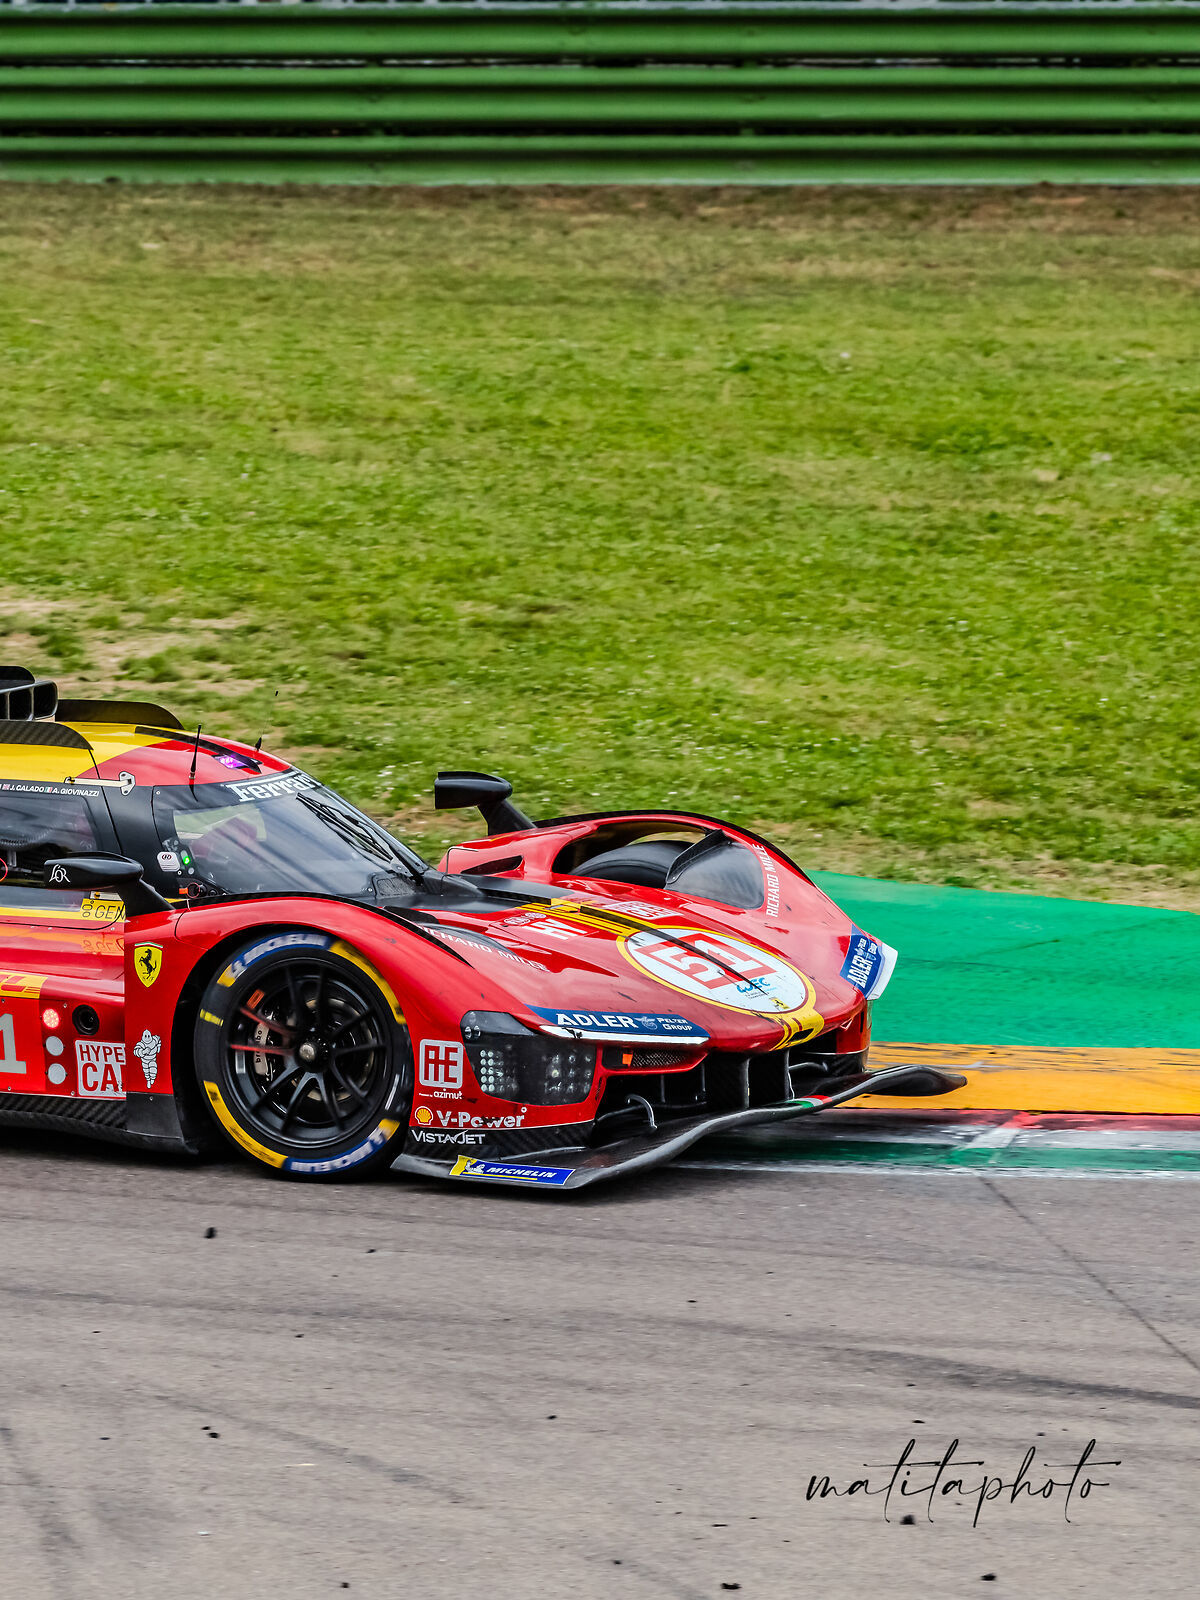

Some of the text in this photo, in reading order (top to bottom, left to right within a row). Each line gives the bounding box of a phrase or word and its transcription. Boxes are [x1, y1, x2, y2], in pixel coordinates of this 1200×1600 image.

[16, 784, 45, 793] CALADO
[60, 788, 100, 797] GIOVINAZZI
[765, 873, 780, 918] RICHARD
[649, 939, 764, 983] 51
[556, 1013, 638, 1029] ADLER
[79, 1044, 125, 1063] HYPE
[433, 1088, 463, 1100] azimut
[436, 1110, 525, 1128] V-Power
[486, 1167, 558, 1178] MICHELIN
